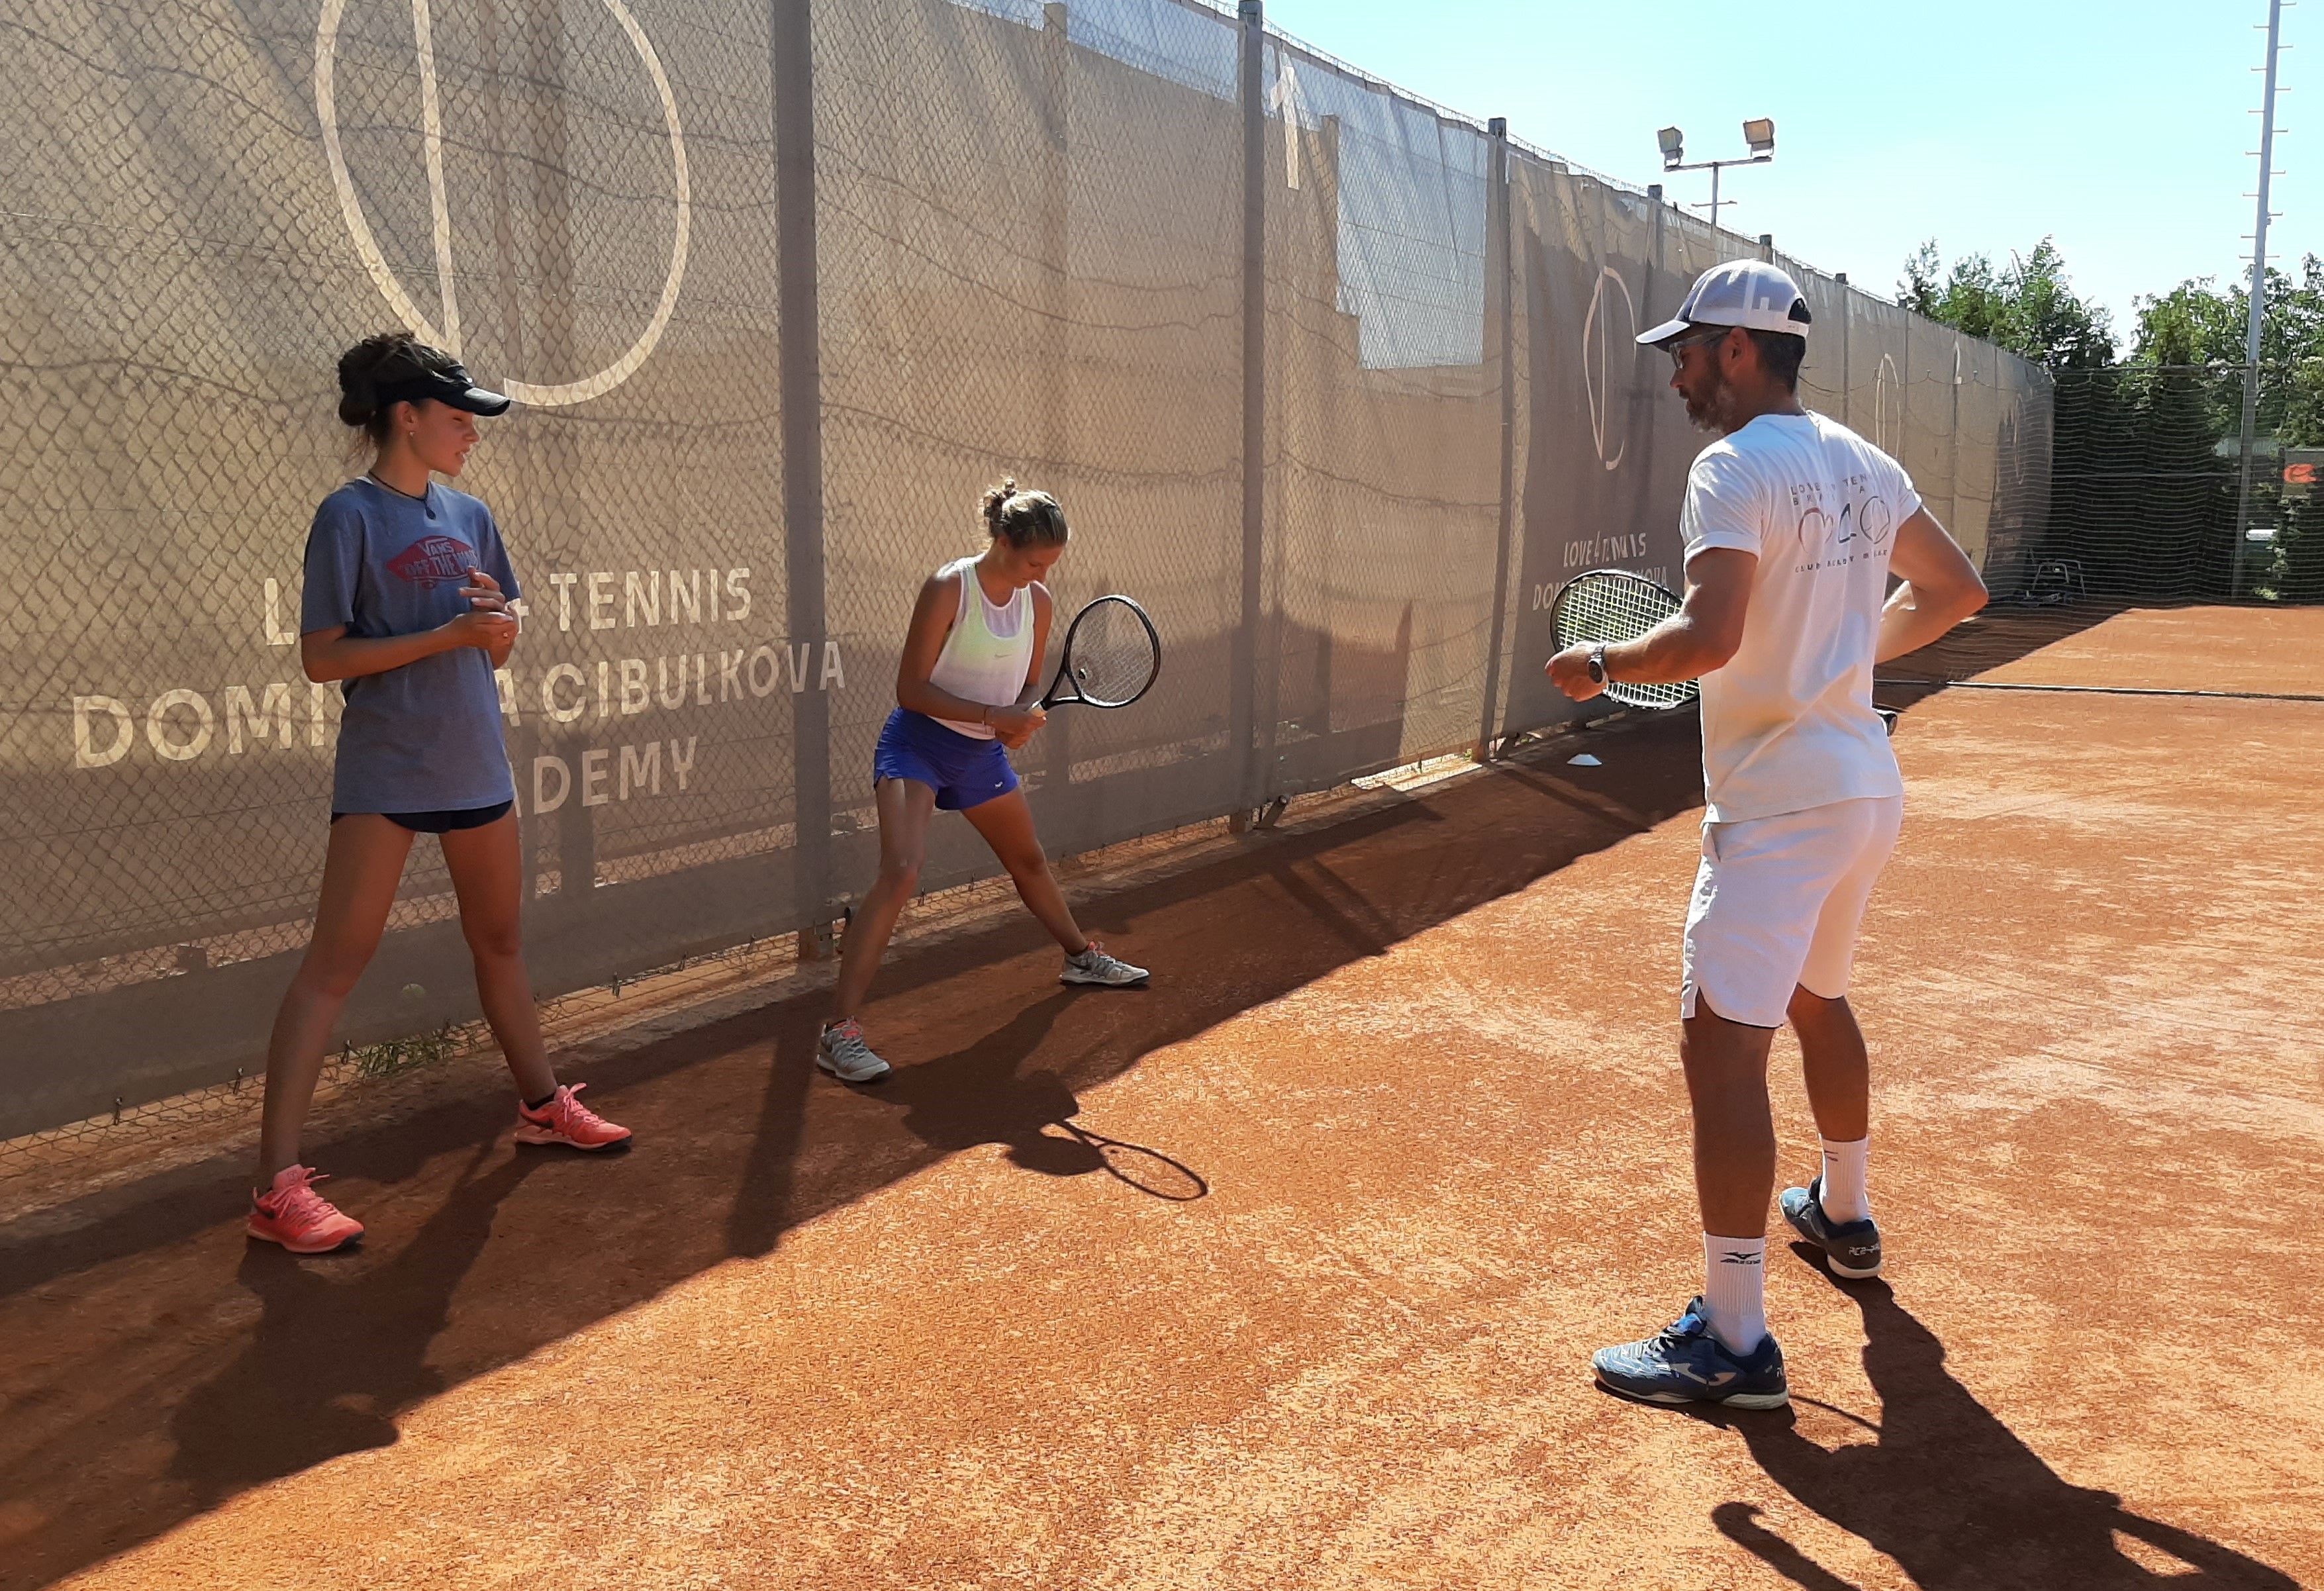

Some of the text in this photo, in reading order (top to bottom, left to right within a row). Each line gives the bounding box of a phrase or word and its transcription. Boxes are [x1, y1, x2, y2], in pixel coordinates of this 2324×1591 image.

[417, 537, 454, 557] VANS
[429, 554, 458, 576] THE
[1563, 540, 1593, 568] LOVE
[550, 567, 752, 632] TENNIS
[542, 640, 846, 723] CIBULKOVA
[512, 736, 697, 818] DEMY
